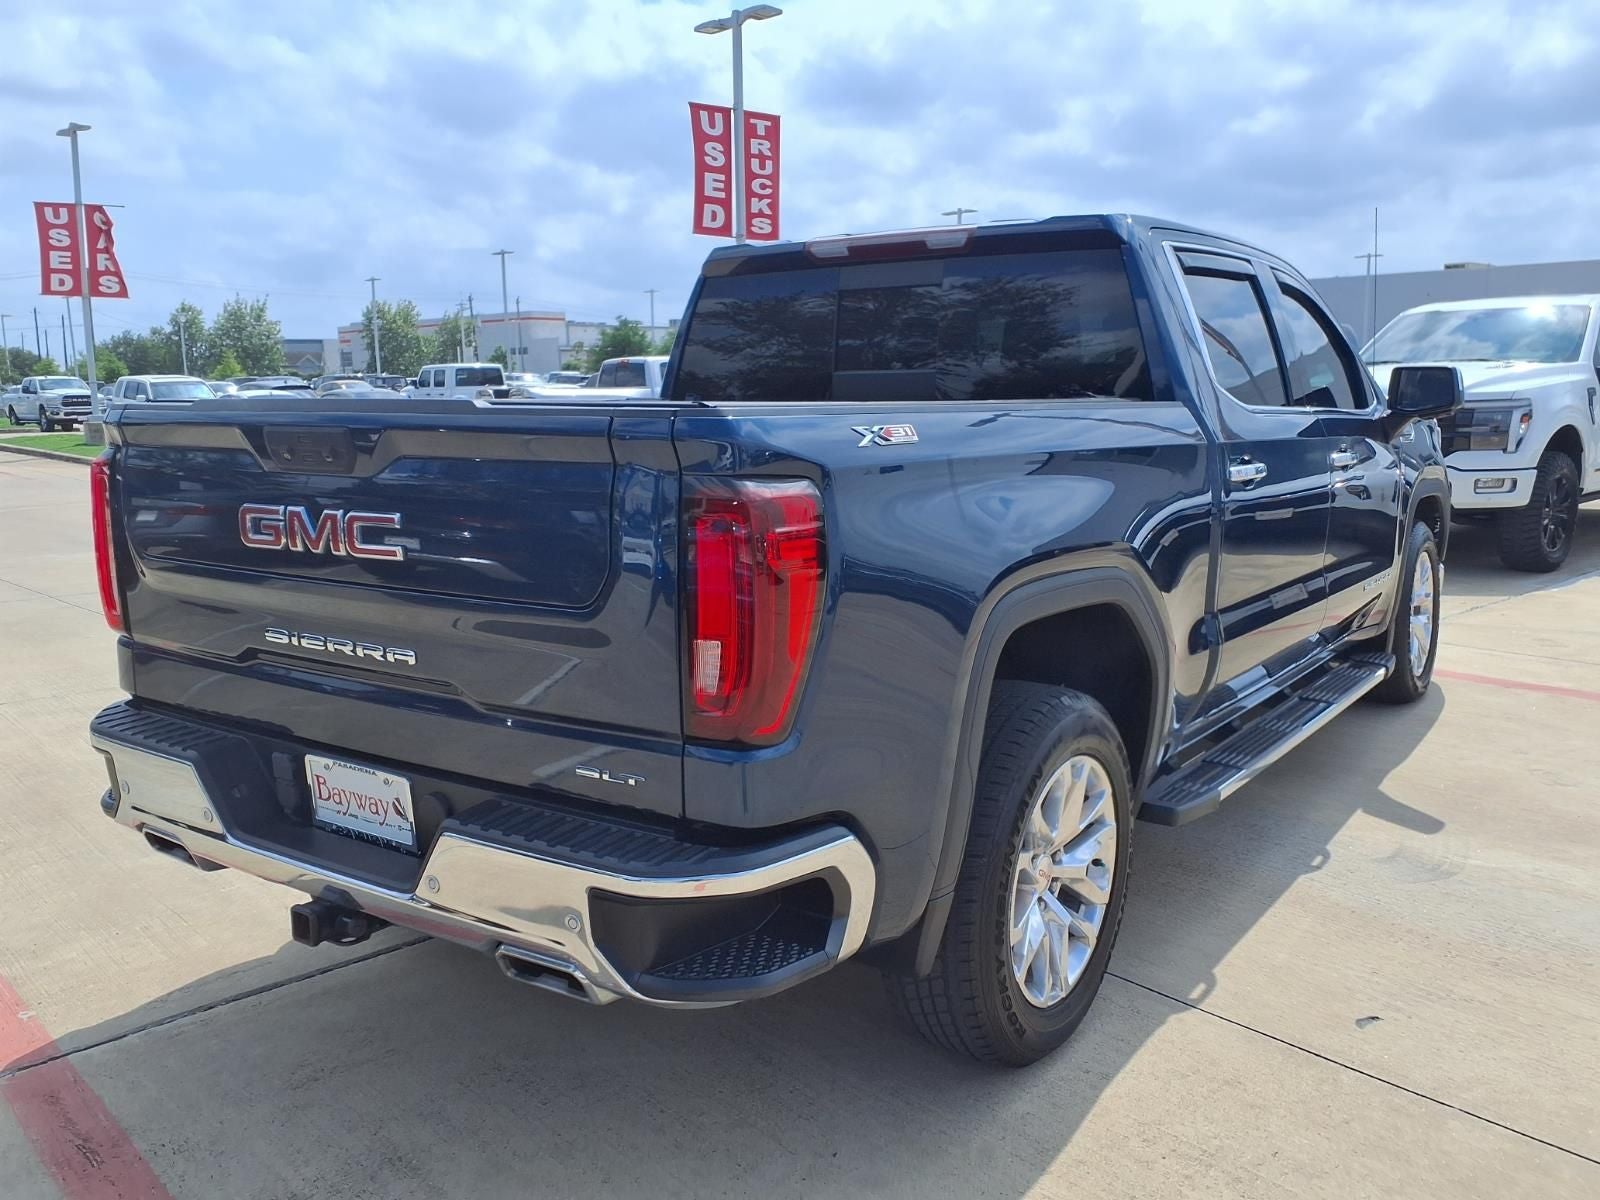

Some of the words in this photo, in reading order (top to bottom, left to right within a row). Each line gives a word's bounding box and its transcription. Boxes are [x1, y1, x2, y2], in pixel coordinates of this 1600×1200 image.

[700, 110, 726, 229] USED
[749, 118, 773, 234] TRUCKS
[43, 206, 74, 292] USED
[93, 211, 120, 294] CARS
[850, 424, 918, 446] X31
[238, 503, 404, 561] GMC
[264, 627, 417, 665] SIERRA
[314, 774, 390, 826] Bayway
[575, 765, 646, 786] SLT
